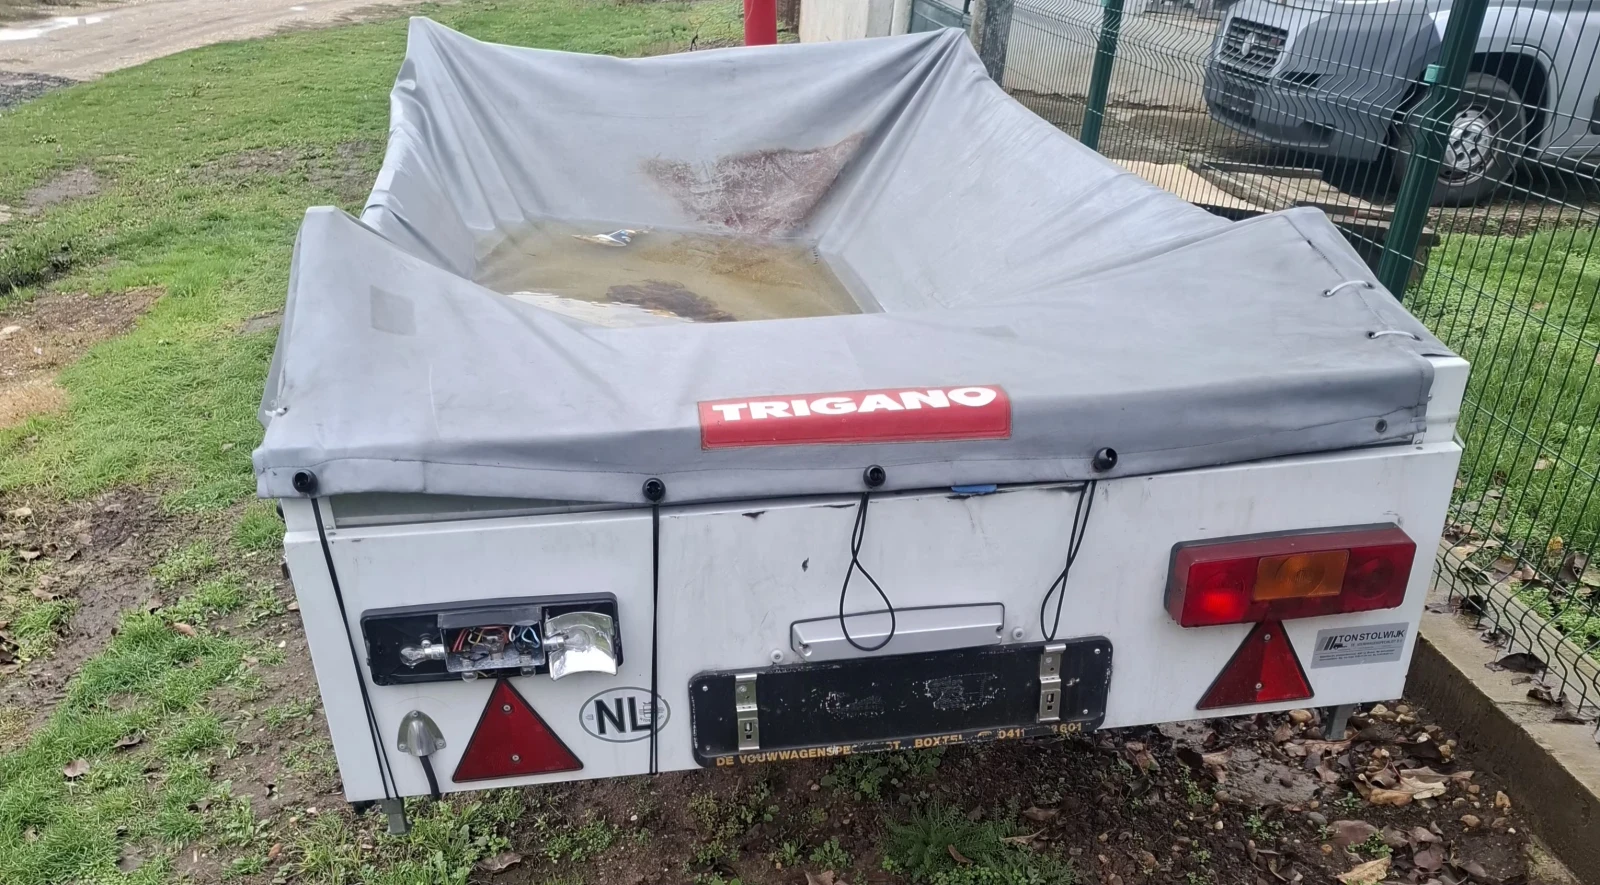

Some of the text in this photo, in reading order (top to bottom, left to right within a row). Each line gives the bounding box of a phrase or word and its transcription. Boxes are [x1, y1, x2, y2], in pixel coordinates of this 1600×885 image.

[712, 387, 997, 421] TRIGANO
[1338, 634, 1358, 643] TON
[1359, 629, 1405, 641] STOLWIJK
[594, 696, 653, 735] NL
[716, 756, 734, 767] DE
